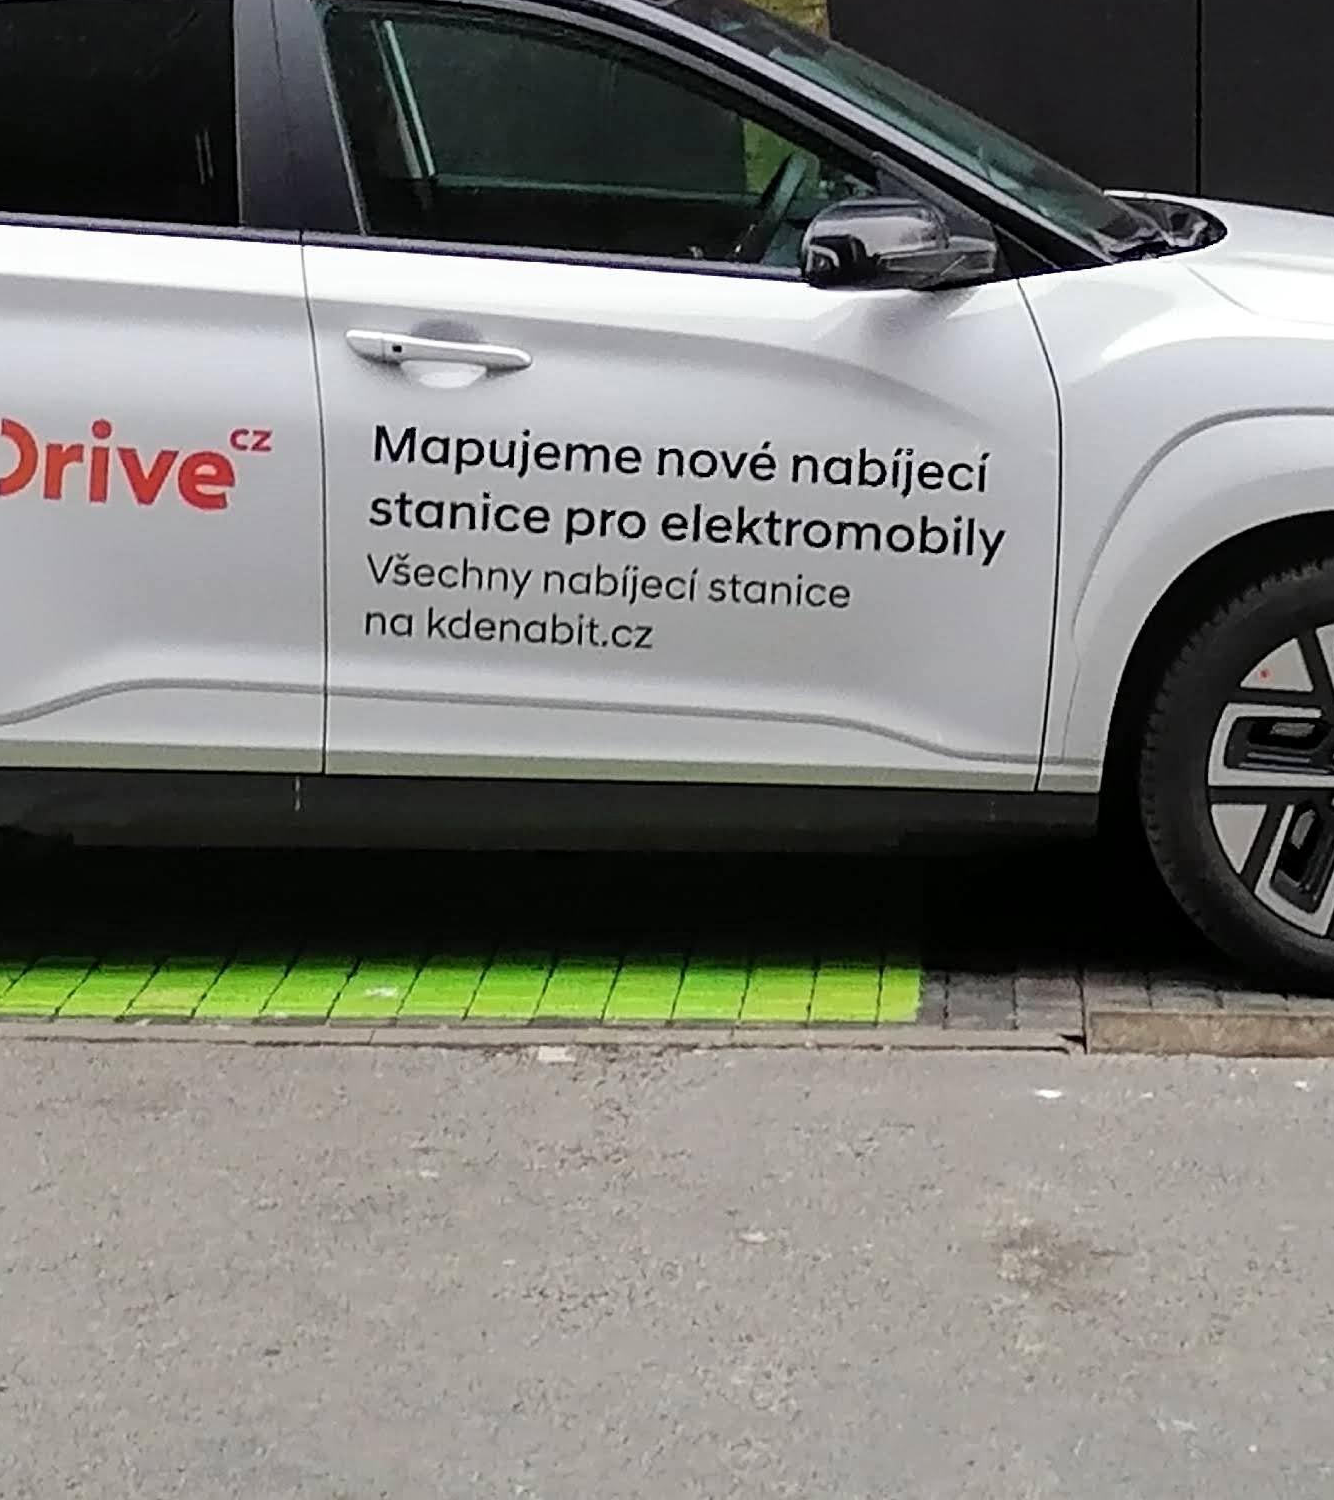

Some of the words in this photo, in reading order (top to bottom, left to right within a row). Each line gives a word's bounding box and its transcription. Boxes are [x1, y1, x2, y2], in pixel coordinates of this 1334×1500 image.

[374, 425, 642, 479] Mapujeme
[657, 440, 777, 482] nové
[791, 448, 991, 498] nabíjecí
[369, 492, 551, 535] stanice
[566, 506, 647, 545] pro
[660, 503, 1006, 567] elektromobily
[367, 553, 533, 600] Všechny
[543, 563, 698, 605] nabíjecí
[707, 573, 851, 608] stanice
[366, 611, 414, 638] na
[427, 606, 654, 649] kdenabit.cz
